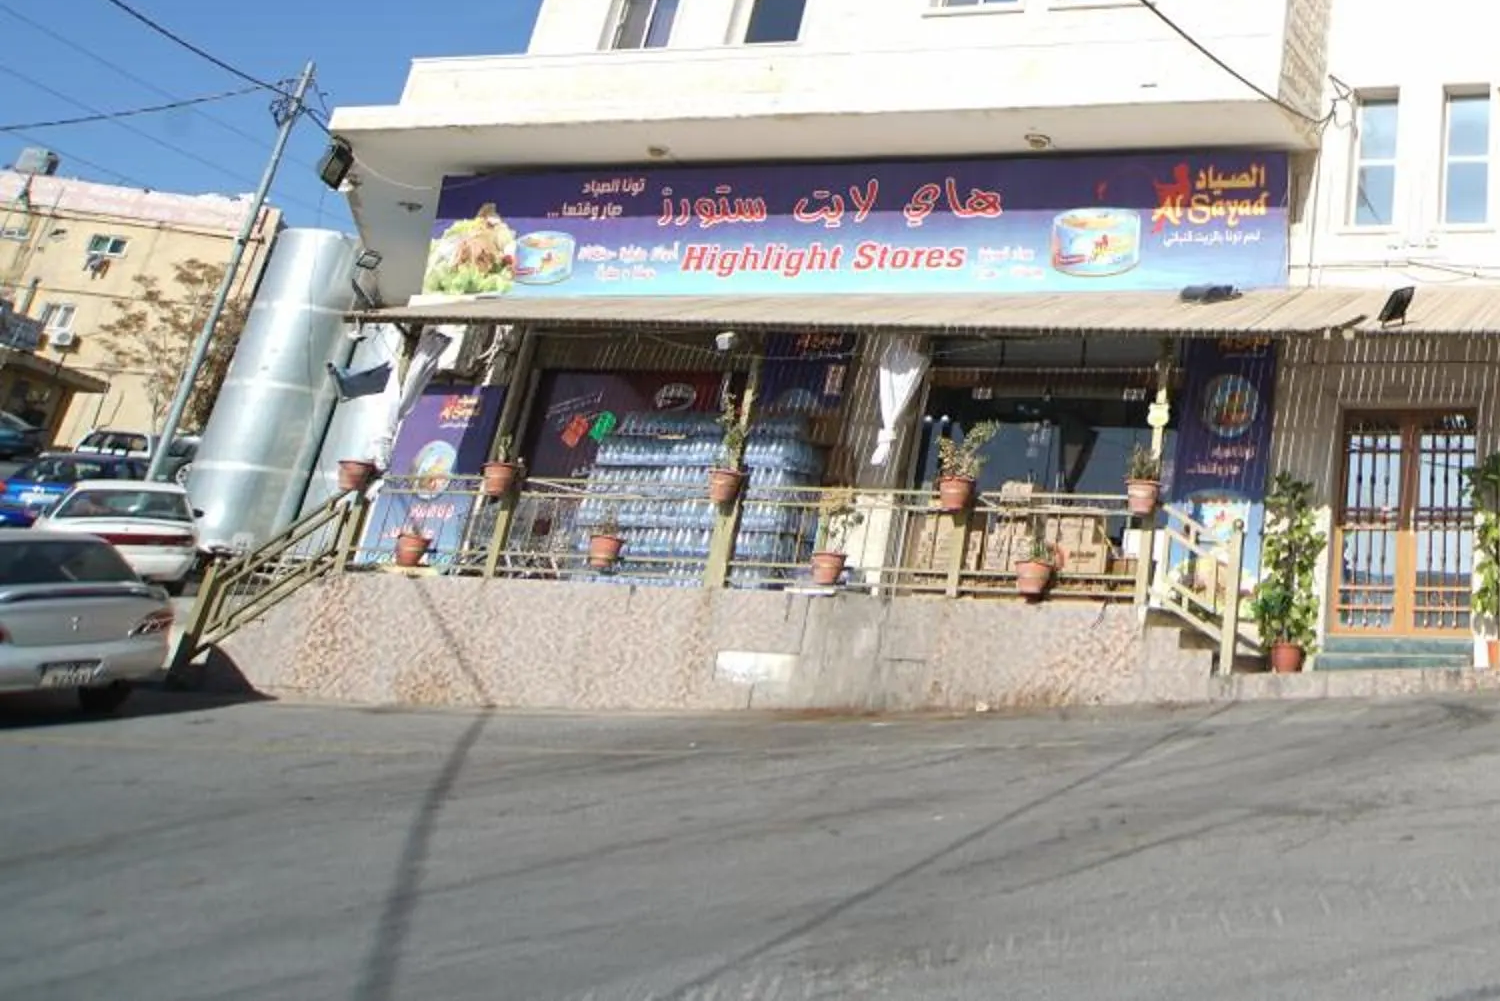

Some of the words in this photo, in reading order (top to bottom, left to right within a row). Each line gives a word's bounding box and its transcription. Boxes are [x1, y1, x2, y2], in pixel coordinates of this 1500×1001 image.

[1195, 163, 1265, 195] الصياد
[657, 185, 767, 228] ستورز
[793, 179, 879, 228] لايت
[903, 177, 1003, 228] هاي
[1151, 194, 1183, 226] Al
[1188, 191, 1270, 227] Sayad
[680, 241, 843, 278] Highlight
[852, 241, 966, 271] Stores
